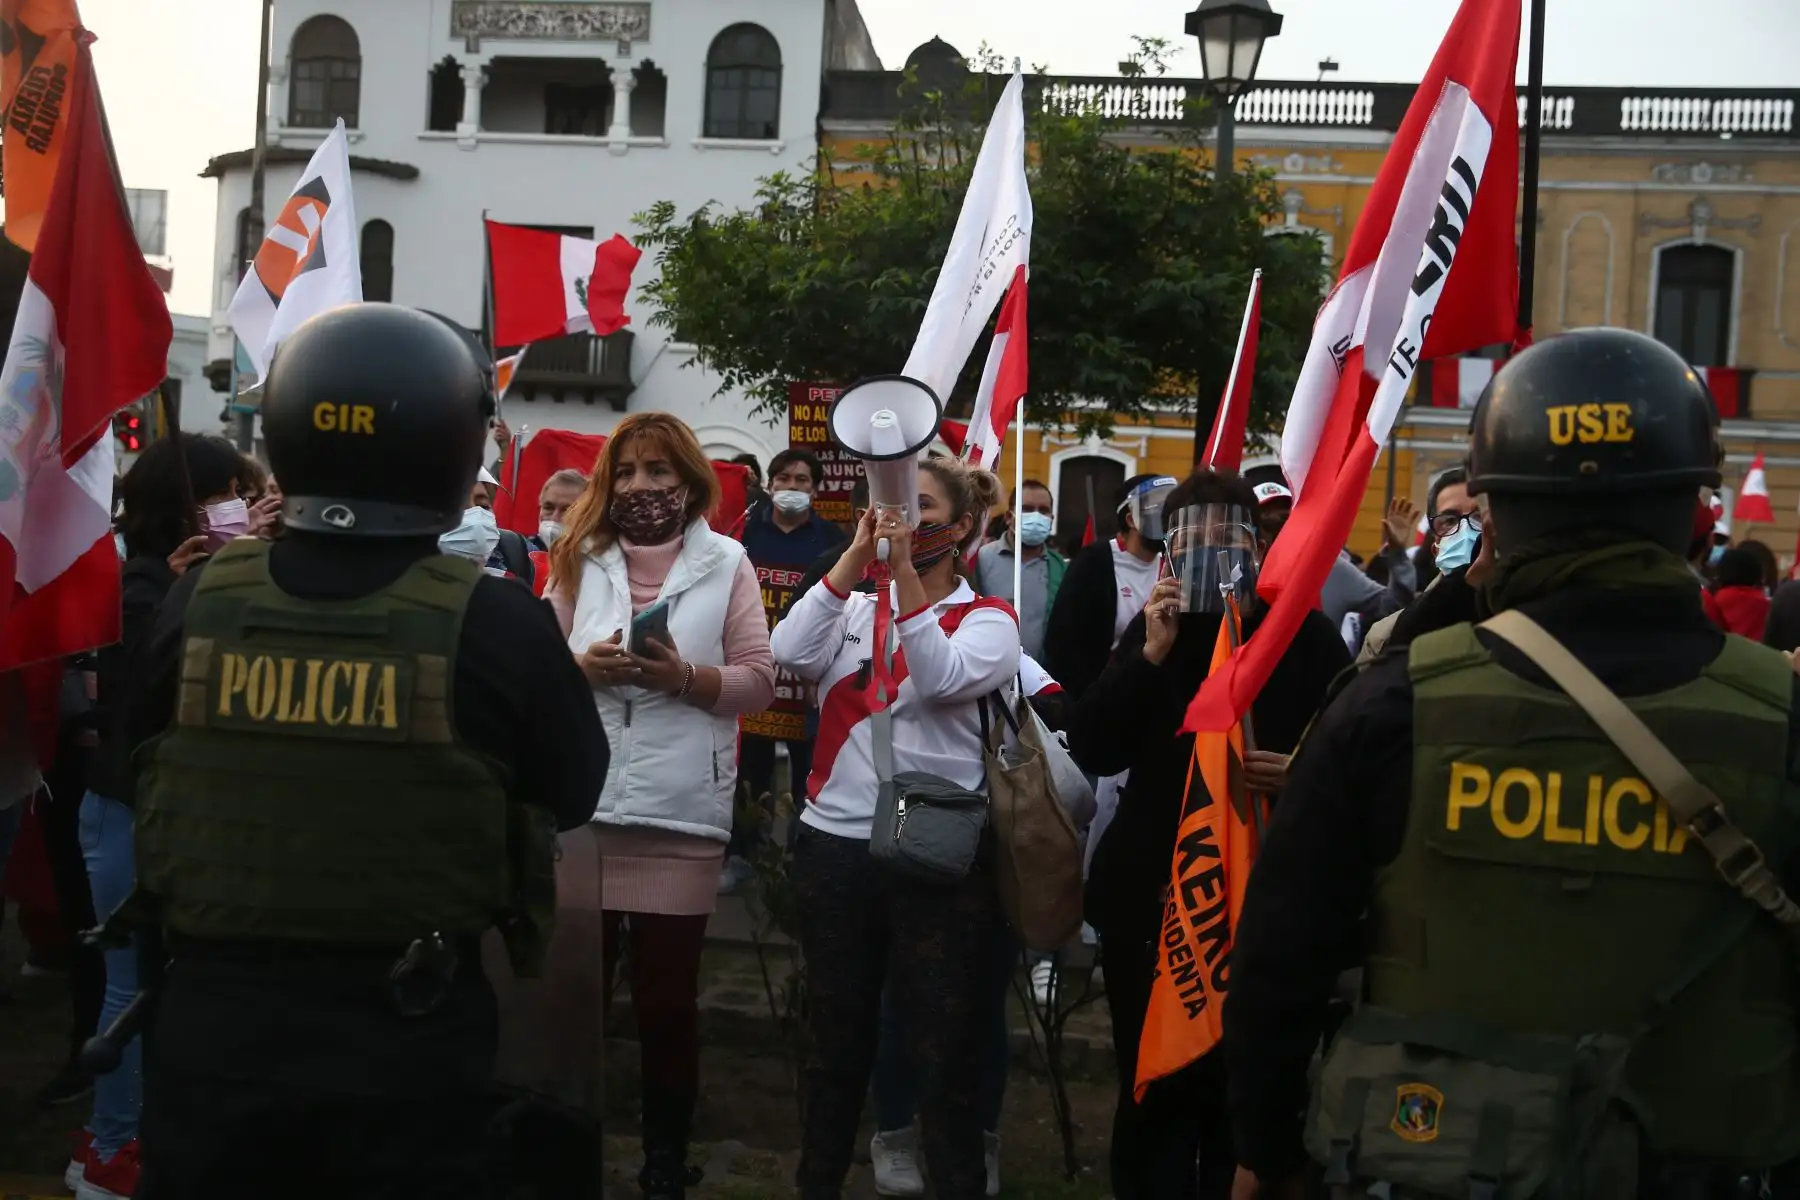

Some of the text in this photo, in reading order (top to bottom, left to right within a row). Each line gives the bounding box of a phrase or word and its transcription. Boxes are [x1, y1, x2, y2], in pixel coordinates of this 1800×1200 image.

[313, 402, 375, 434] GIR
[794, 405, 828, 421] NO AL
[1546, 403, 1634, 445] USE
[791, 426, 804, 442] DE
[806, 427, 826, 442] LOS
[216, 652, 399, 729] POLICIA
[1446, 761, 1691, 855] POLICI
